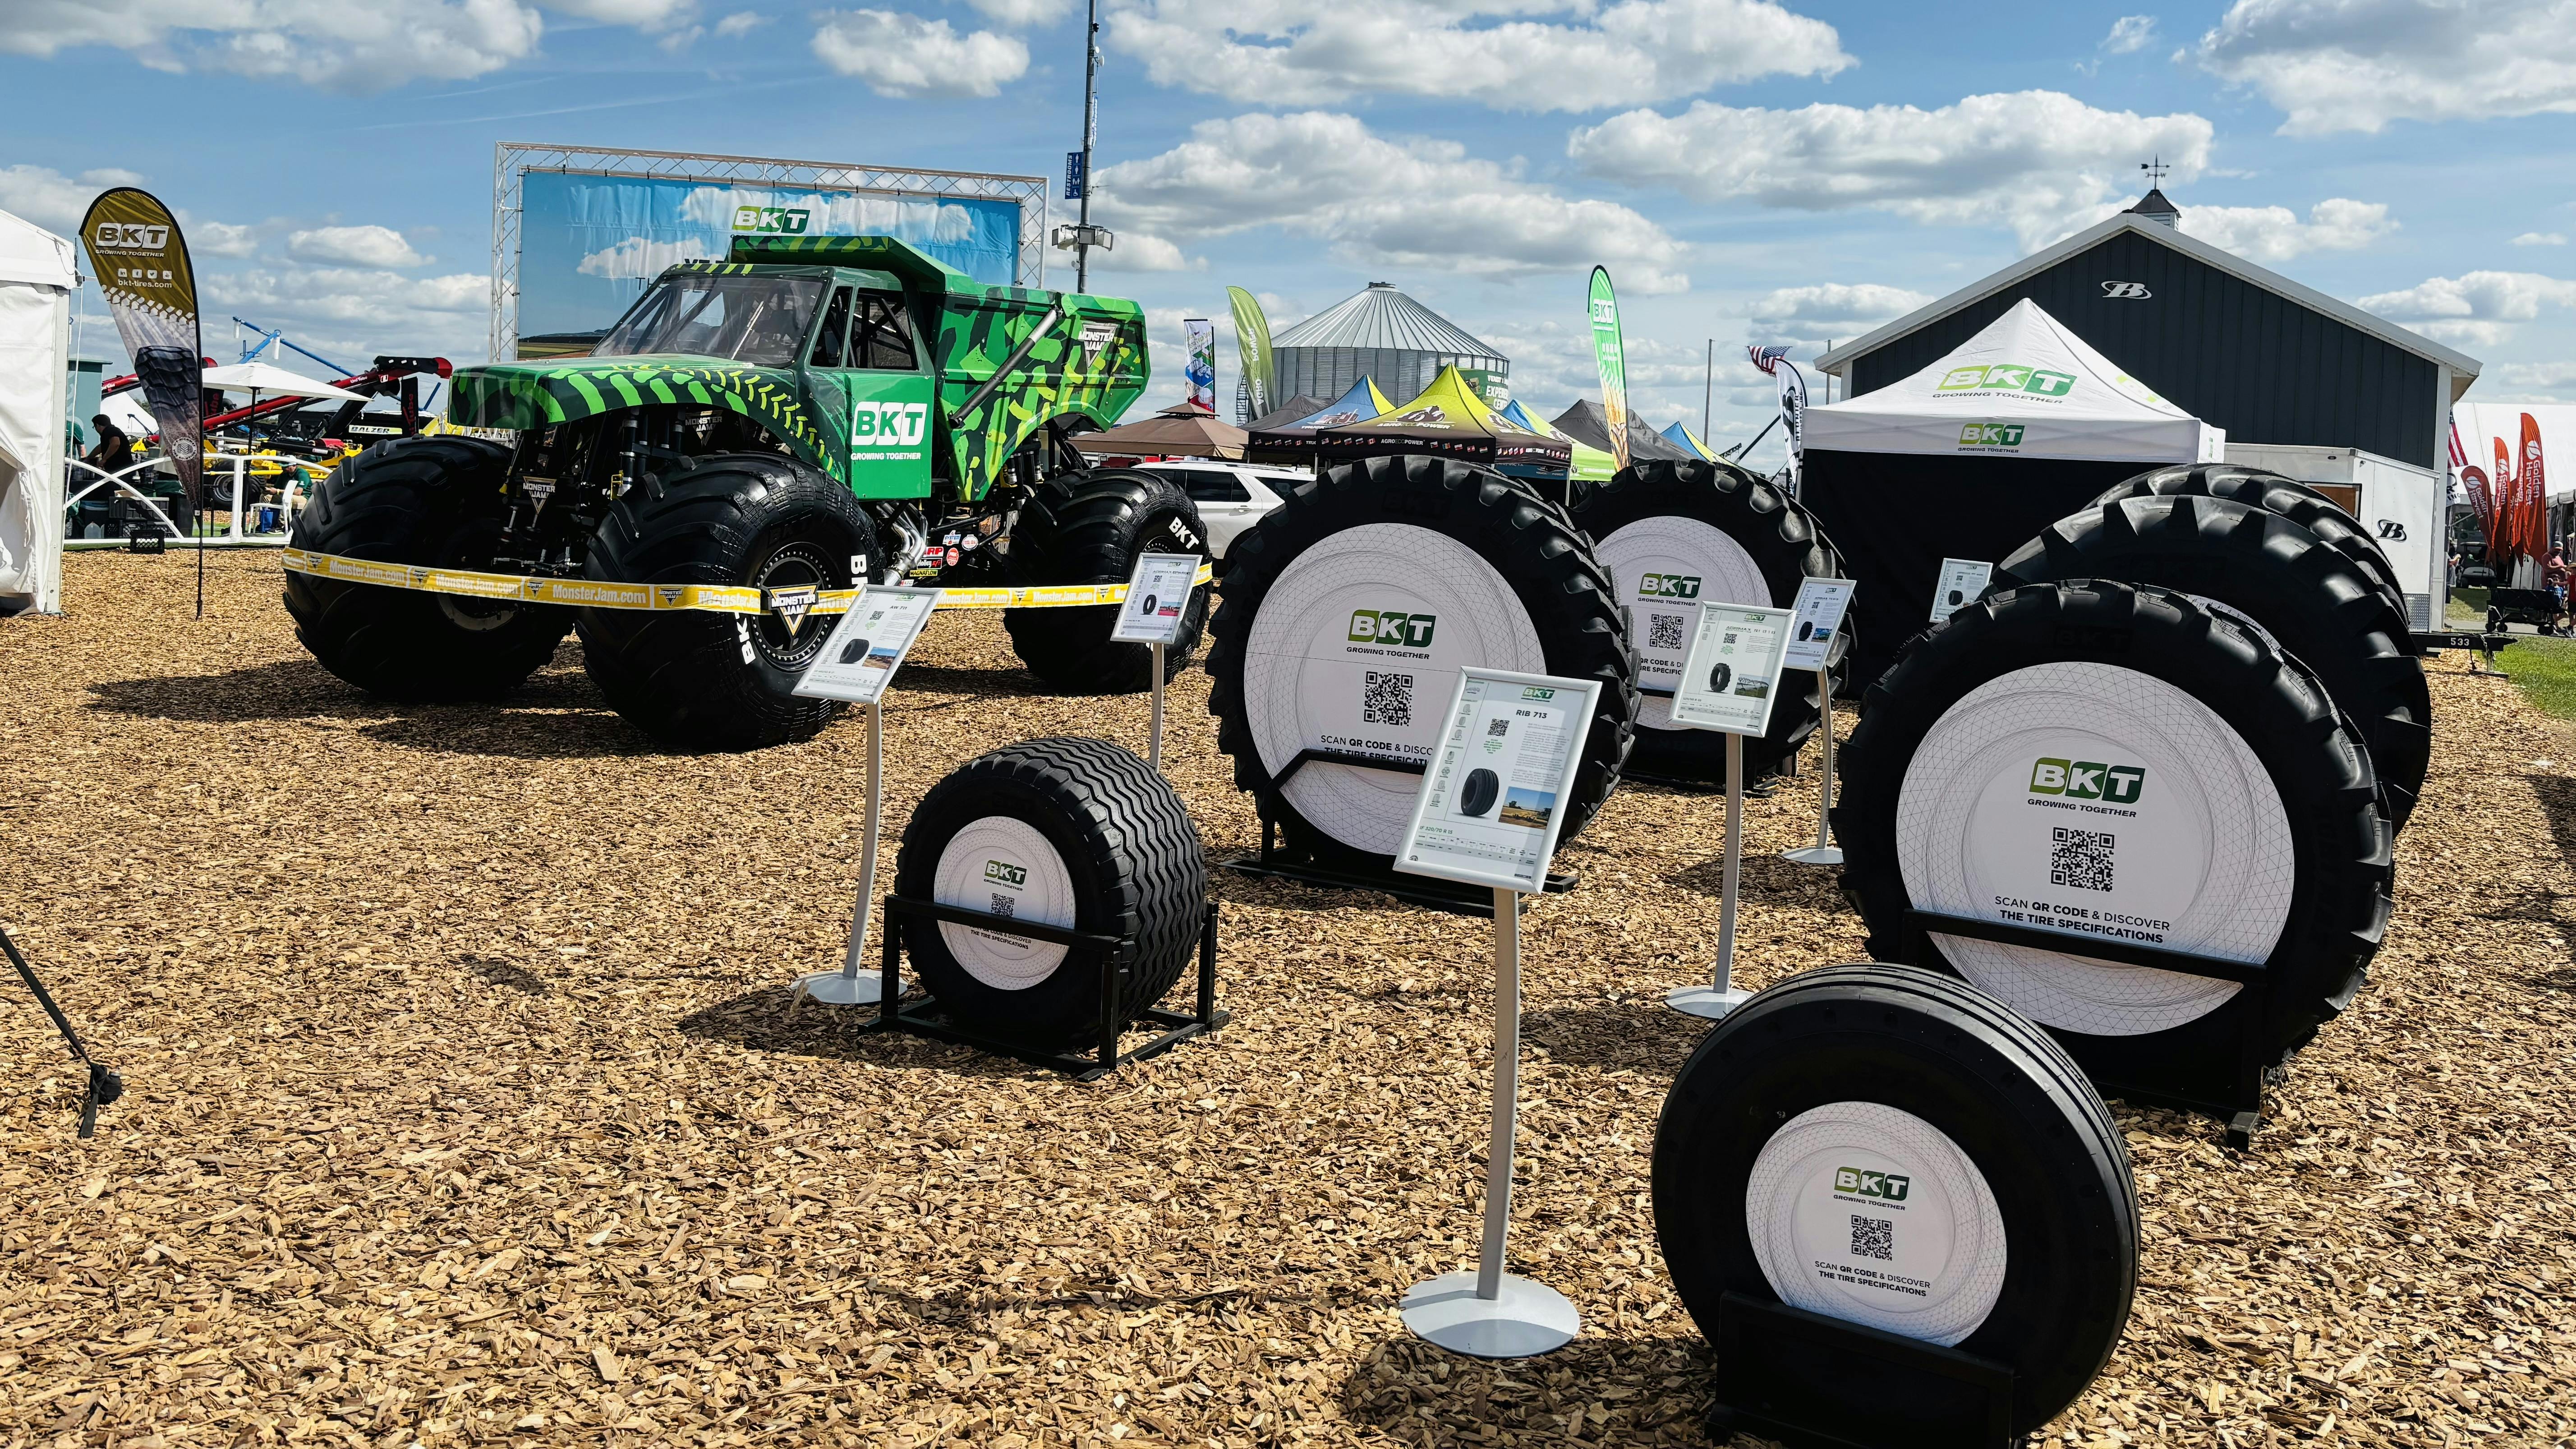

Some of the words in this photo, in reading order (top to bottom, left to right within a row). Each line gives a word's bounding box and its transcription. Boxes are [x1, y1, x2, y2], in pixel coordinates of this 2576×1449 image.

[733, 208, 808, 231] BKT
[97, 225, 168, 246] BKT
[118, 279, 172, 288] bkt-tires.com
[1594, 301, 1613, 321] BKT
[1078, 331, 1115, 342] MONSTER
[1086, 341, 1103, 351] JAM
[1940, 367, 2074, 394] BKT
[1996, 392, 2063, 404] TOGETHER
[853, 406, 925, 441] BKT
[1960, 425, 2023, 444] BKT
[851, 452, 884, 460] GROWING
[523, 483, 556, 492] MONSTER
[2533, 460, 2541, 498] Golden
[1384, 492, 1449, 517] BKT
[2469, 490, 2484, 519] Harvest
[2475, 487, 2488, 513] Golden
[1168, 516, 1200, 549] BKT
[329, 560, 405, 582] MonsterJam.com
[435, 573, 519, 594] MonsterJam.com
[1640, 575, 1700, 596] BKT
[552, 584, 646, 604] MonsterJam.com
[771, 594, 816, 608] MONSTER
[939, 591, 1008, 604] MonsterJam.com
[1033, 591, 1092, 603] MonsterJam.com
[784, 604, 805, 616] JAM
[1349, 612, 1434, 644] BKT
[2451, 637, 2470, 646] 533
[1346, 647, 1384, 655] GROWING
[1386, 650, 1430, 659] TOGETHER
[1523, 688, 1554, 698] BKT
[1320, 735, 1346, 745] SCAN
[1349, 738, 1362, 747] QR
[1366, 740, 1392, 750] CODE
[2031, 760, 2143, 800] BKT
[2028, 799, 2076, 810] GROWING
[2079, 805, 2137, 818] TOGETHER
[985, 861, 1026, 883] BKT
[1003, 883, 1023, 892] TOGETHER
[1995, 896, 2028, 909] SCAN
[2031, 901, 2050, 913] QR
[2053, 905, 2089, 919] CODE
[2091, 910, 2100, 920] &
[2104, 912, 2171, 931] DISCOVER
[990, 929, 1003, 937] CODE
[1008, 934, 1032, 944] DISCOVER
[2000, 909, 2024, 922] THE
[2027, 913, 2055, 926] TIRE
[2057, 918, 2163, 944] SPECIFICATIONS
[991, 935, 1029, 950] SPECIFICATIONS
[1835, 1168, 1908, 1199] BKT
[1833, 1194, 1866, 1204] GROWING
[1868, 1200, 1906, 1211] TOGETHER
[1815, 1260, 1838, 1271] SCAN
[1840, 1265, 1852, 1274] QR
[1854, 1268, 1877, 1279] CODE
[1887, 1274, 1931, 1288] DISCOVER
[1818, 1270, 1835, 1279] THE
[1837, 1274, 1856, 1283] TIRE
[1858, 1278, 1927, 1297] SPECIFICATIONS
